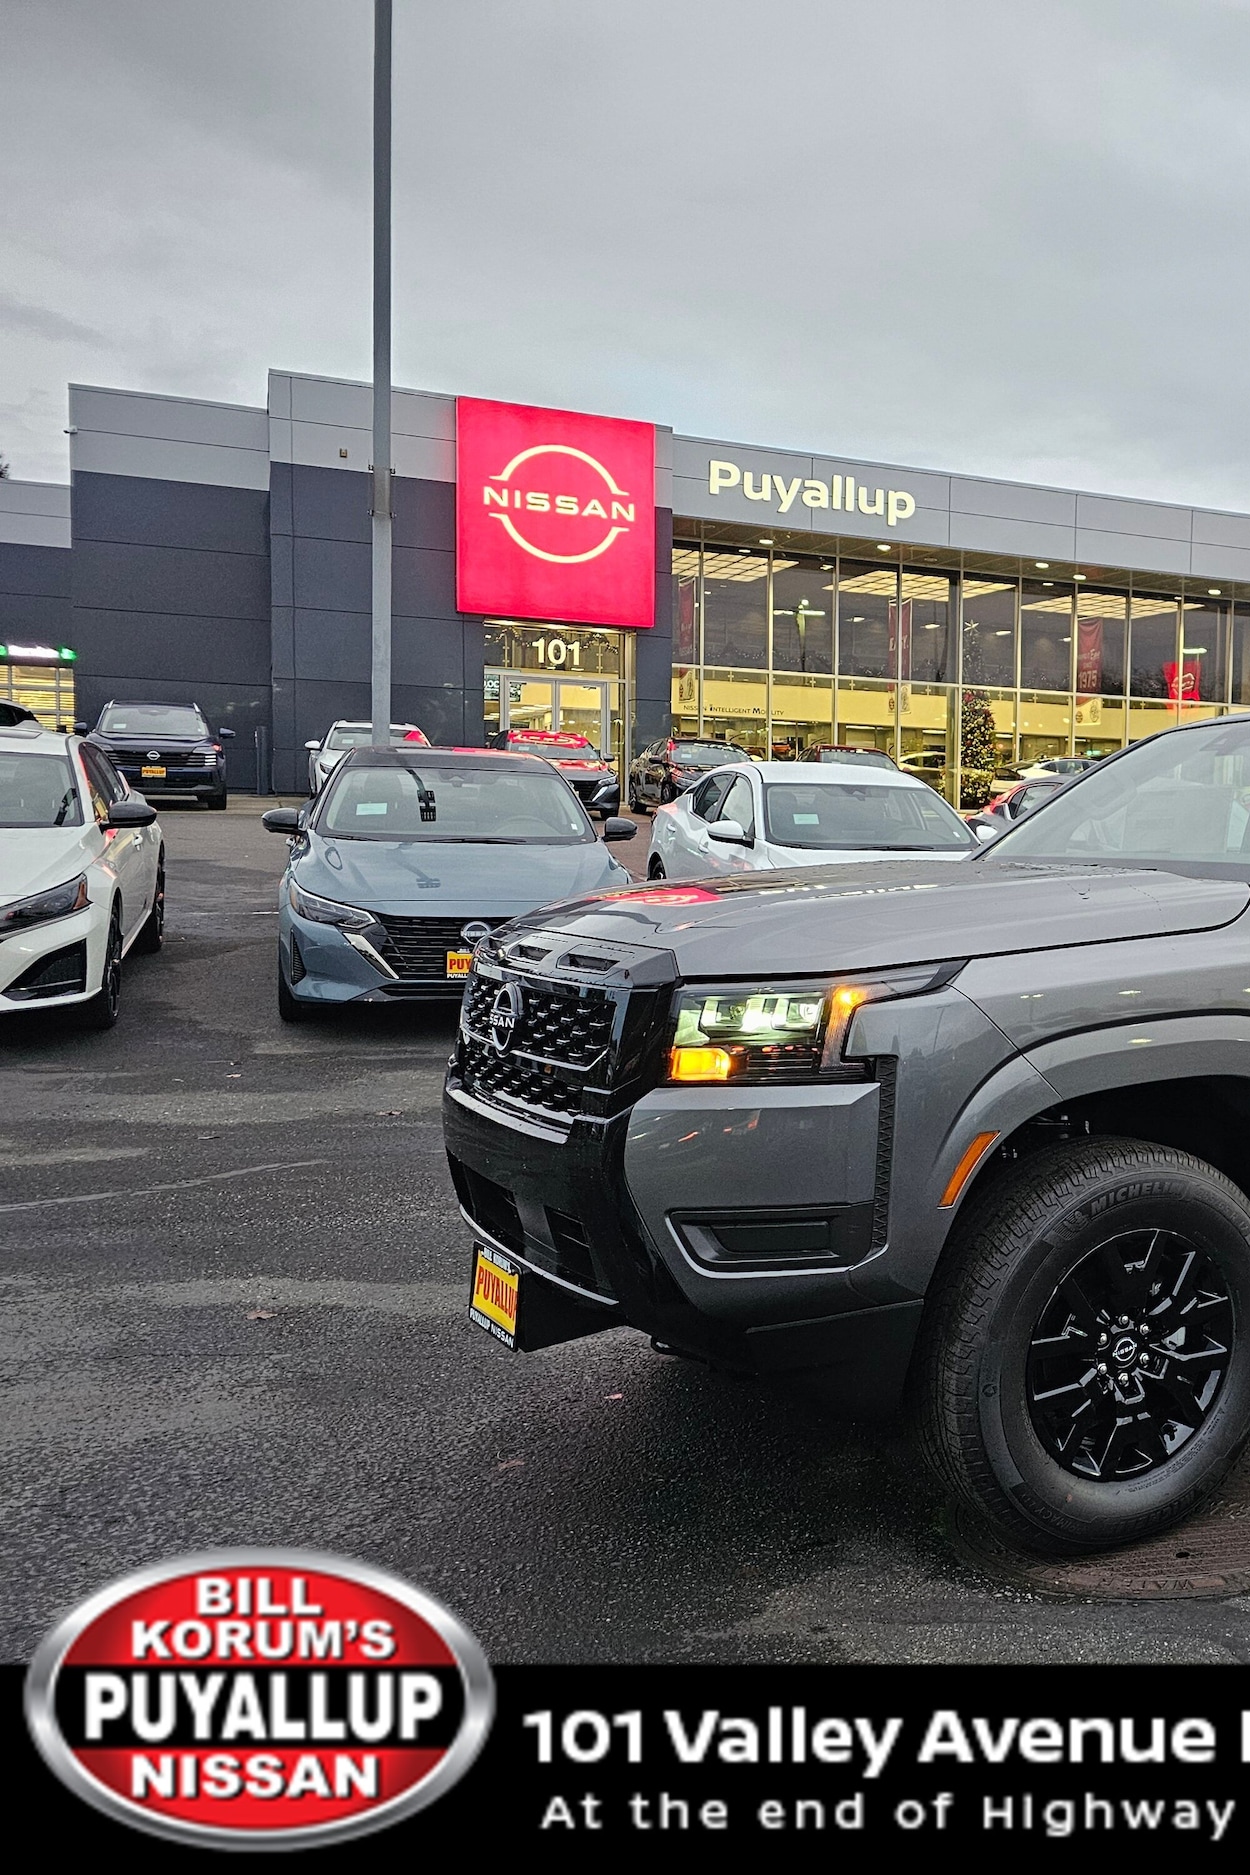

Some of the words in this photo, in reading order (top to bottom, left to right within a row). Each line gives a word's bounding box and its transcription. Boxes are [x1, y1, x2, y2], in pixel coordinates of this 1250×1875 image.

[483, 486, 635, 522] NISSAN
[709, 460, 916, 526] Puyallup
[532, 637, 580, 666] 101
[1078, 670, 1097, 688] 1975
[1090, 1180, 1186, 1216] MICHELIN
[491, 1323, 515, 1349] NISSAN
